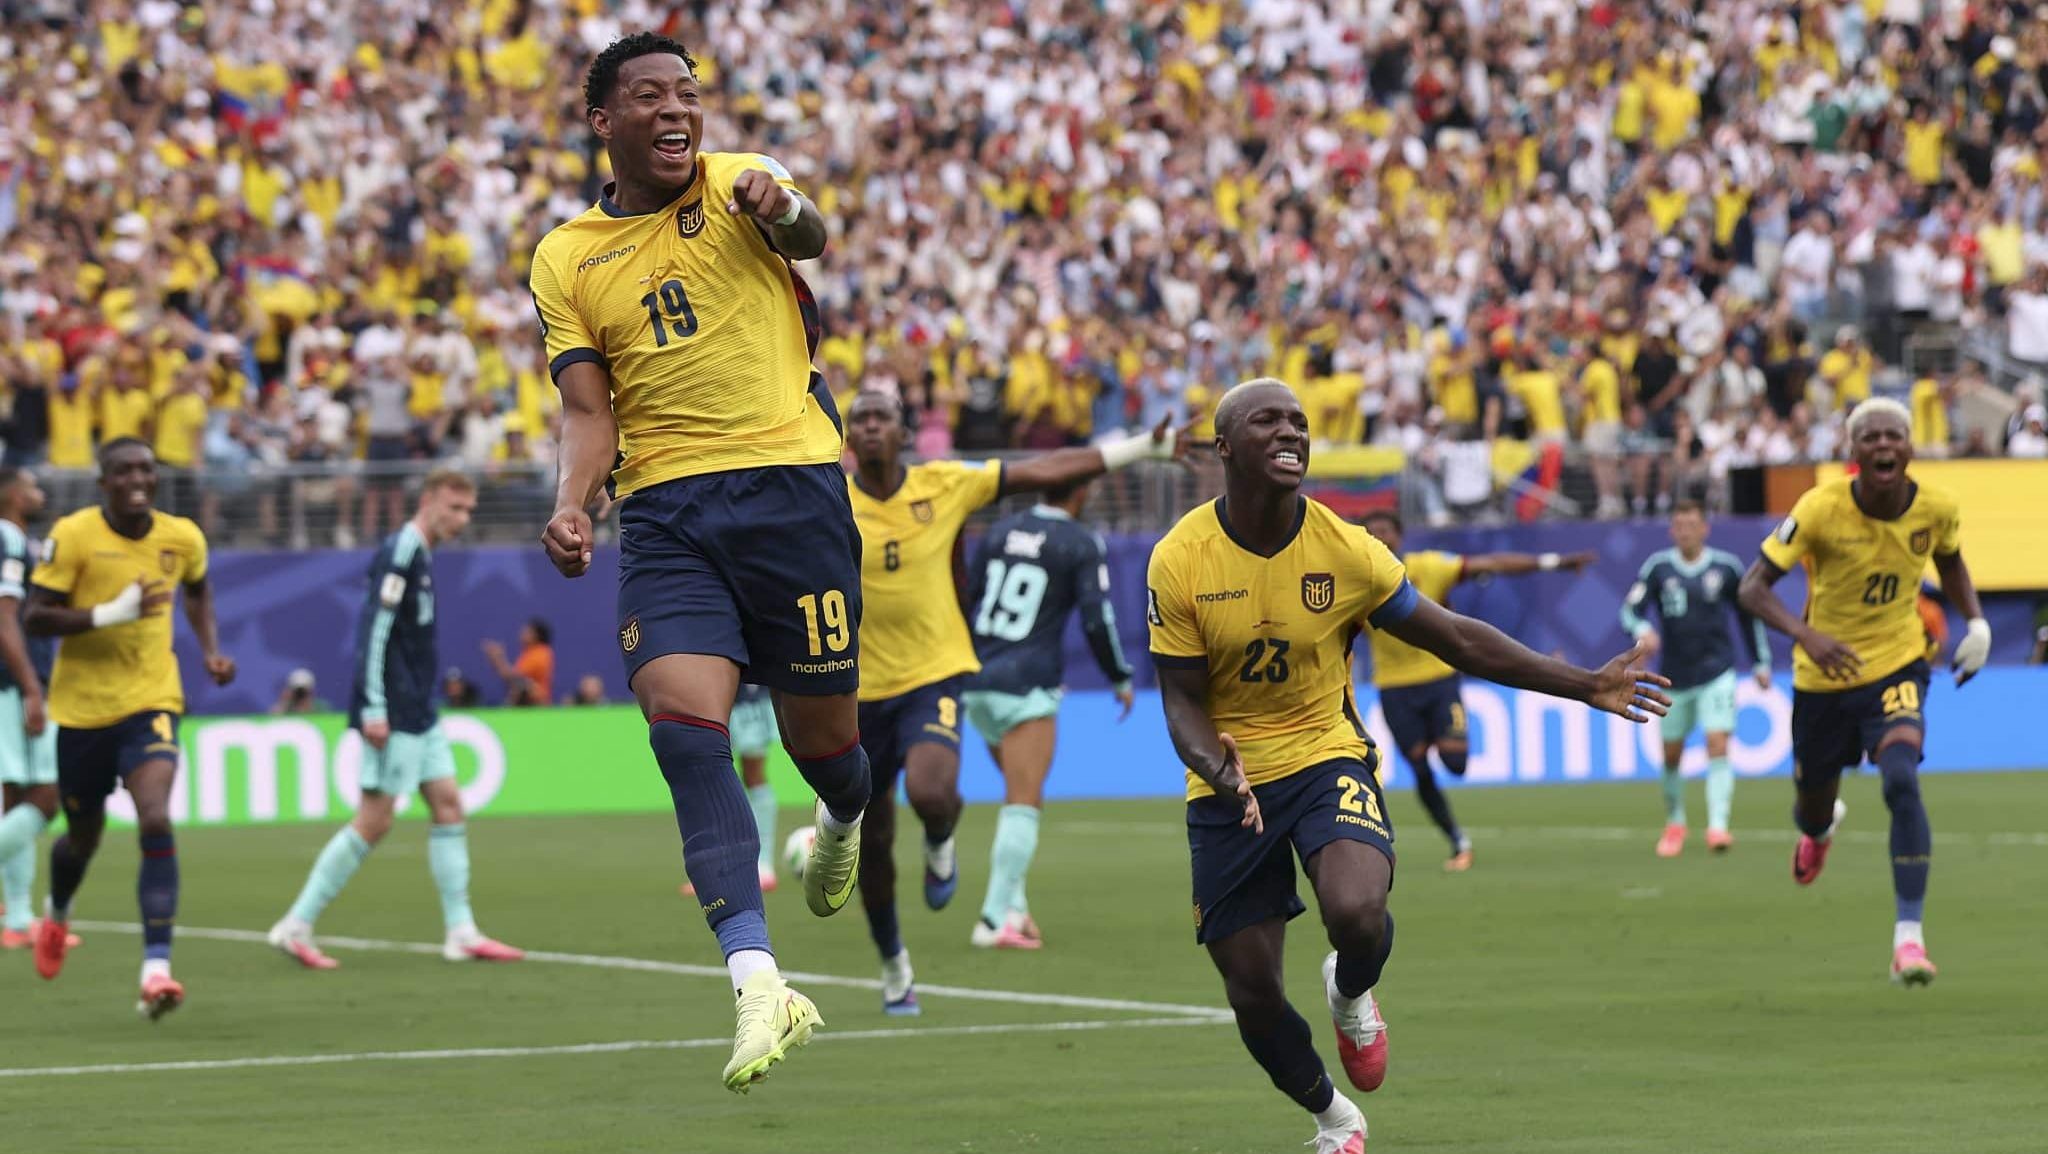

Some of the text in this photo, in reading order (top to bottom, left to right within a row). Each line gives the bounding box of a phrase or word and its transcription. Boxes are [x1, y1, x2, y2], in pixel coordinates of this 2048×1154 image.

[578, 244, 636, 273] marathon
[641, 280, 698, 347] 19
[975, 559, 1048, 642] 19
[1195, 589, 1249, 603] marathon
[1863, 573, 1899, 606] 20
[797, 590, 850, 656] 19
[791, 658, 854, 674] marathon
[1240, 638, 1290, 683] 23
[1882, 680, 1920, 714] 20
[1337, 775, 1383, 823] 23
[1335, 814, 1390, 840] marathon
